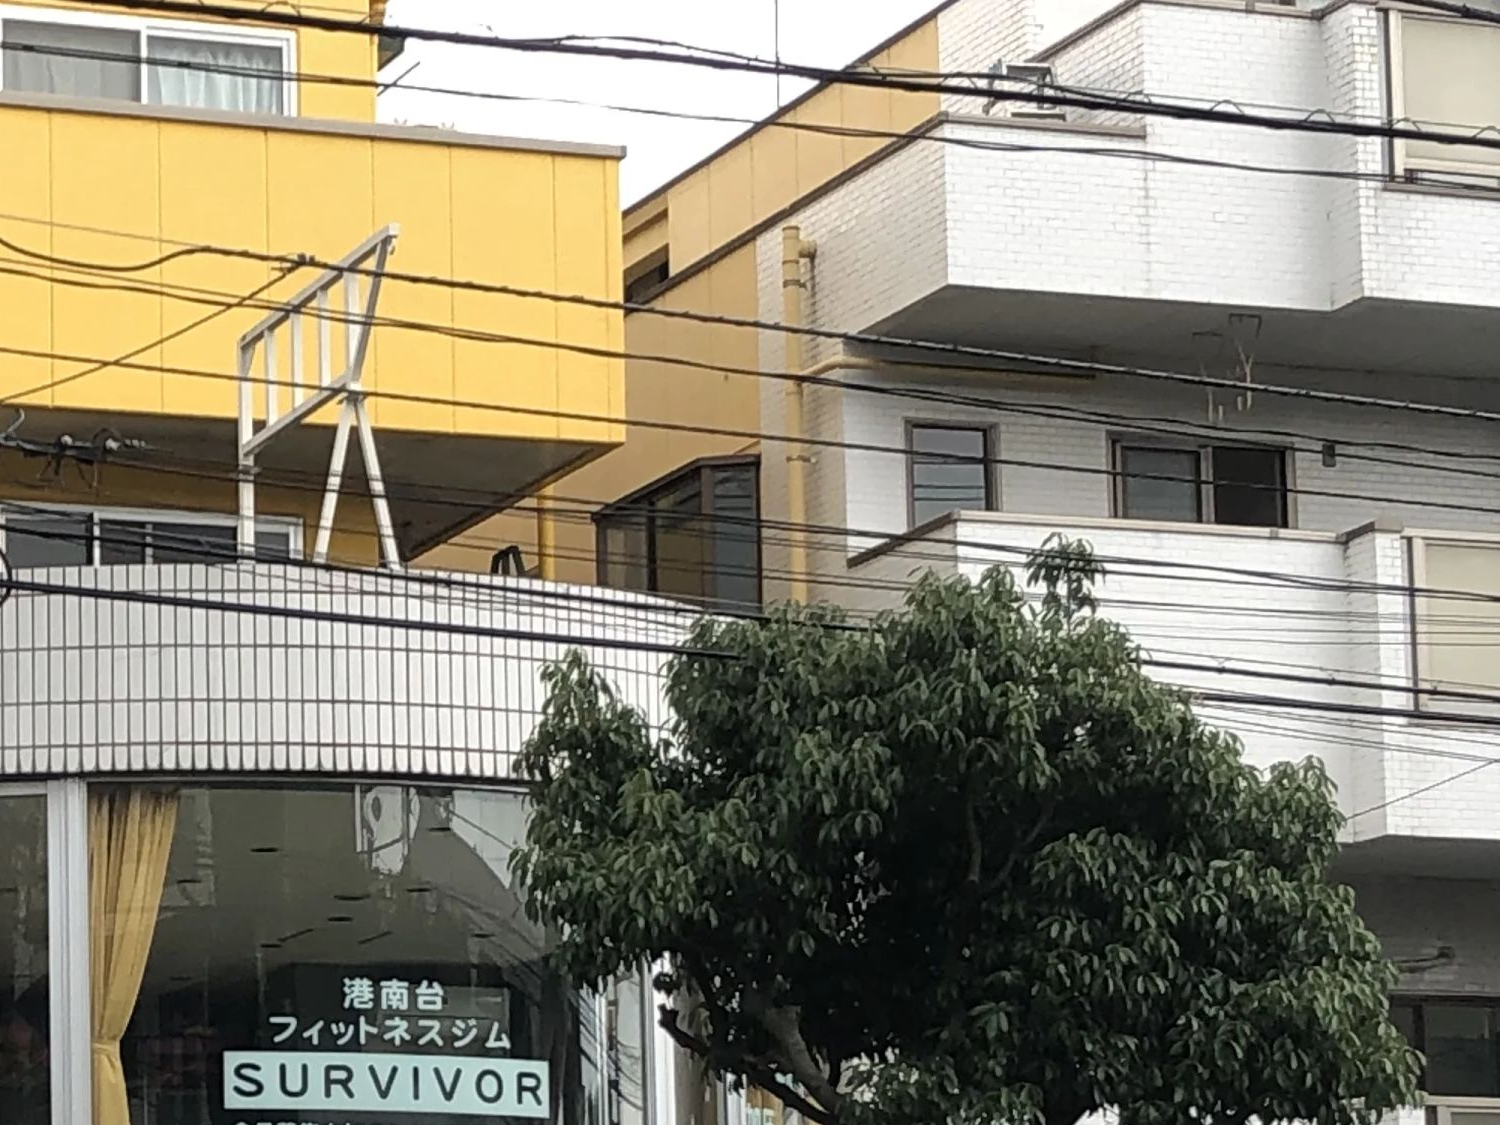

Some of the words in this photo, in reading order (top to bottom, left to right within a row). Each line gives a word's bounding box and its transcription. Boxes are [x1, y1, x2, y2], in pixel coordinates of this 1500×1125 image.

[342, 977, 445, 1012] 港南台
[268, 1016, 512, 1050] フィットネスジム
[231, 1062, 544, 1107] SURVIVOR
